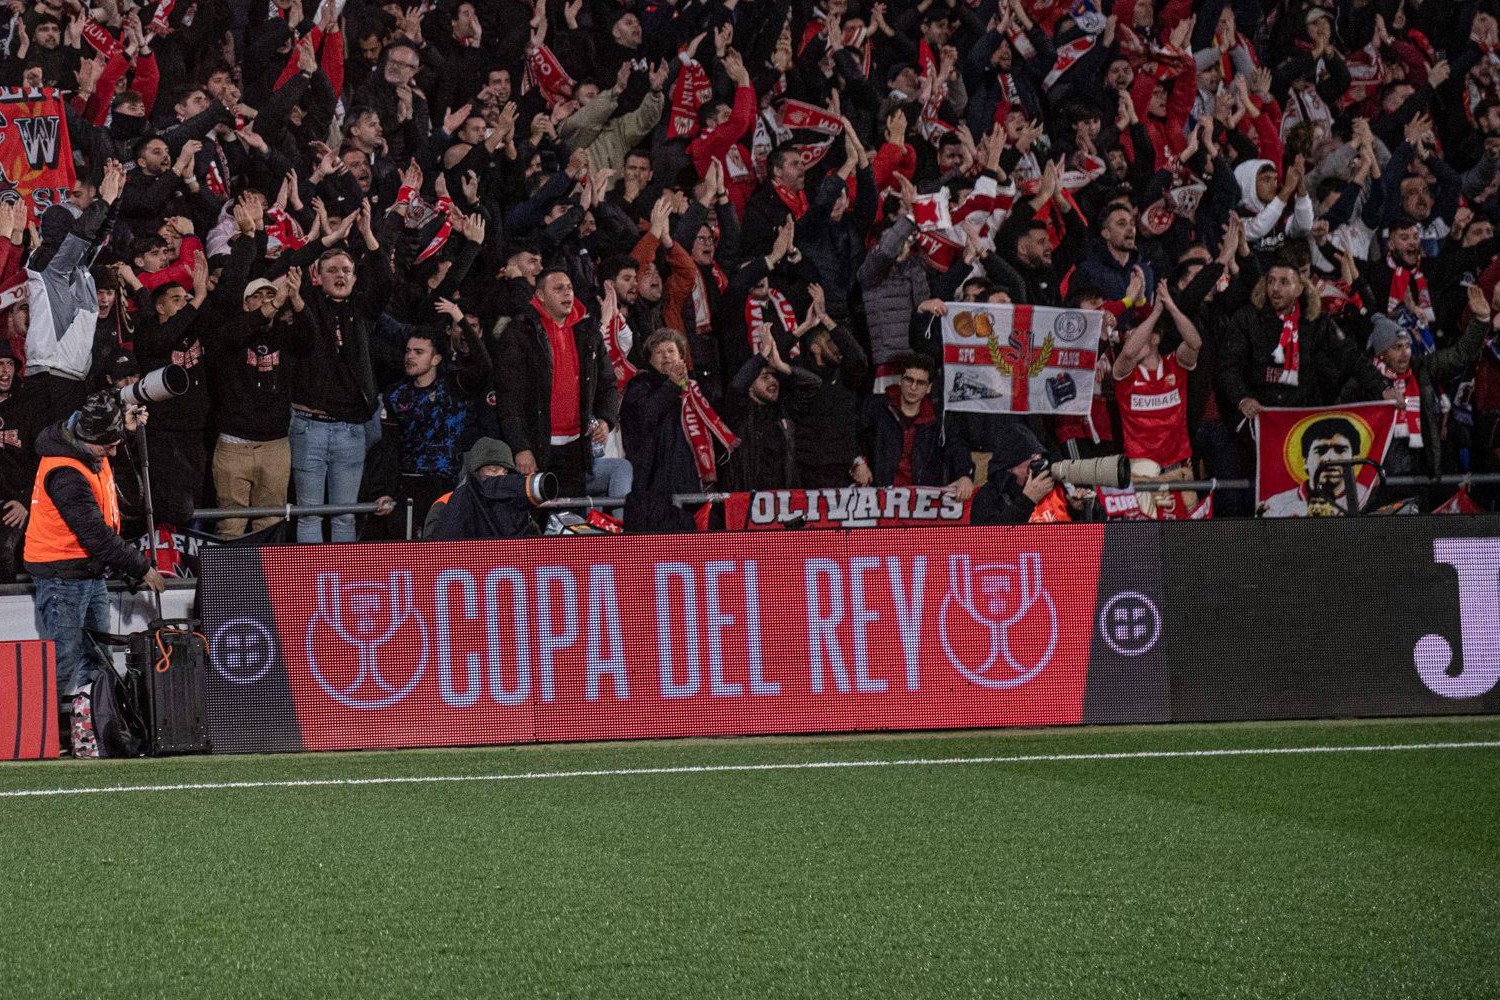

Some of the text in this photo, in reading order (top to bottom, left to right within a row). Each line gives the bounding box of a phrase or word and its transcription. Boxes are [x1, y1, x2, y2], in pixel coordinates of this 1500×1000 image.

[14, 116, 60, 169] W
[750, 485, 965, 529] OLIVARES
[434, 554, 928, 708] COPA DEL REY
